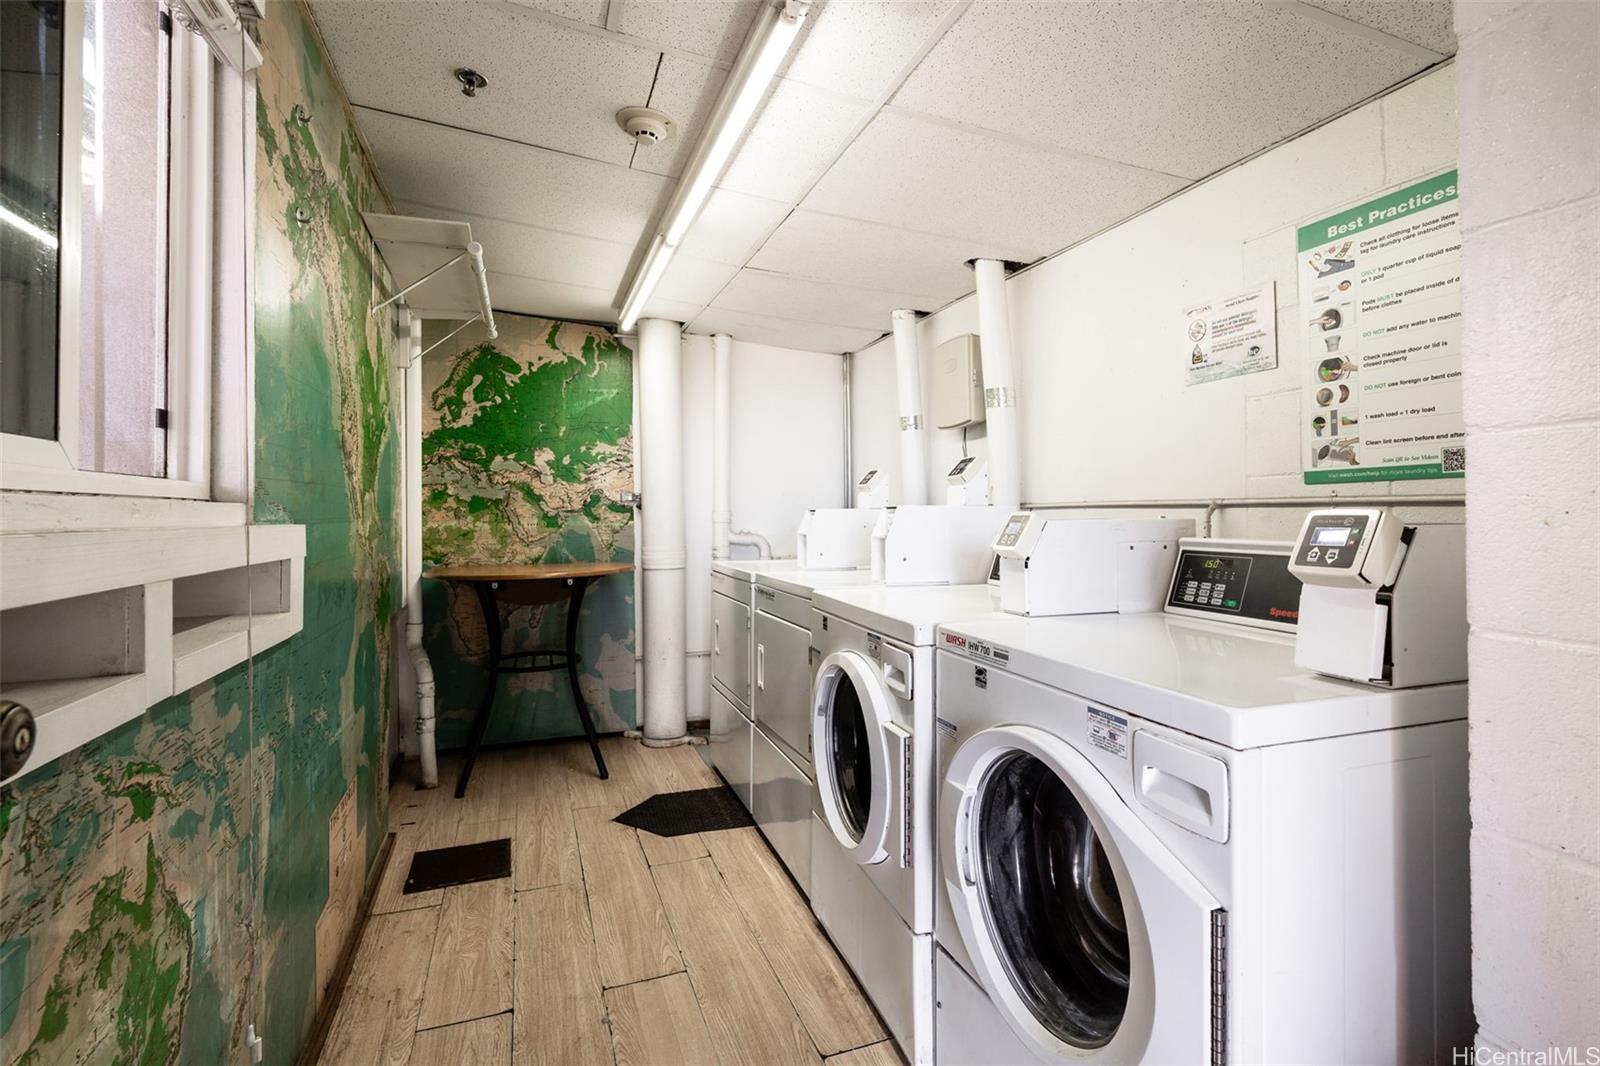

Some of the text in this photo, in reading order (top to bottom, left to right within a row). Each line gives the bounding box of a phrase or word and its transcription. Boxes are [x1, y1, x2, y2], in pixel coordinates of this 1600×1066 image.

[1327, 185, 1456, 238] Best Practices
[1360, 239, 1377, 248] Check
[1386, 228, 1410, 239] clothing
[1422, 219, 1440, 228] loose
[1441, 212, 1459, 221] items
[1380, 238, 1400, 248] laundry
[1418, 220, 1456, 236] instructions
[1361, 269, 1376, 277] ONLY
[1382, 261, 1404, 271] quarter
[1426, 248, 1444, 258] liquid
[1446, 244, 1462, 252] soap
[1377, 294, 1394, 302] MUST
[1404, 286, 1424, 296] placed
[1426, 280, 1445, 290] inside
[1381, 299, 1402, 308] clothes
[1382, 349, 1406, 357] machine
[1383, 356, 1407, 365] properly
[946, 633, 966, 647] WASH
[980, 645, 990, 656] 700
